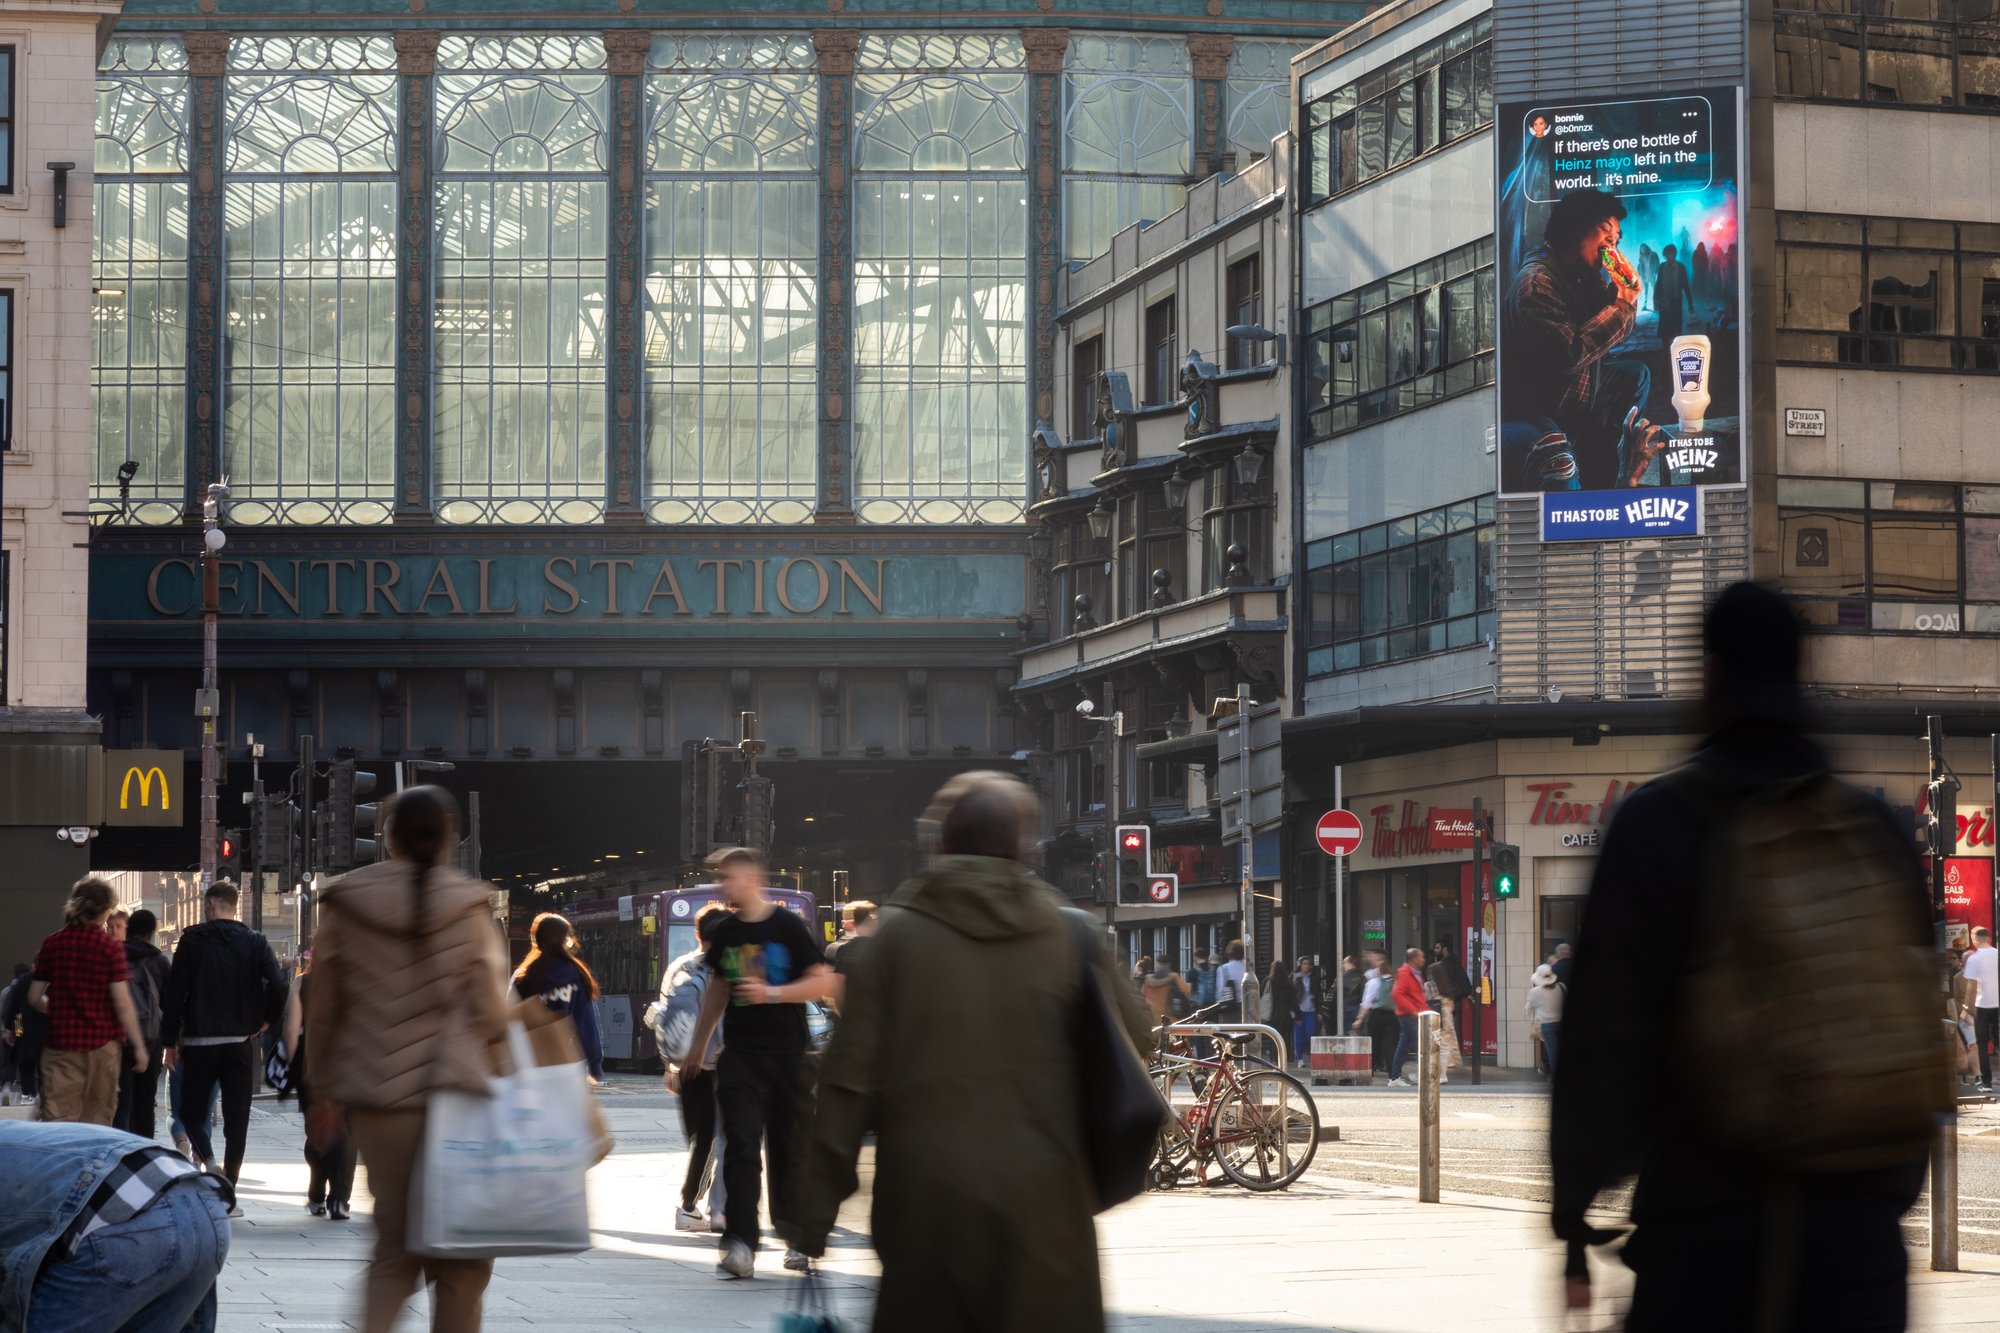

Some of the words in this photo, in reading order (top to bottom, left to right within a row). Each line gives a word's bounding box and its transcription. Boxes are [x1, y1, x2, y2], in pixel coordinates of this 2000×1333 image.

[1555, 113, 1584, 123] bonnie
[1555, 124, 1593, 135] @b0nnzx
[1555, 141, 1563, 153] If
[1567, 138, 1609, 153] there's
[1613, 138, 1638, 149] one
[1641, 133, 1680, 147] bottle
[1683, 131, 1697, 144] of
[1555, 158, 1592, 171] Heinz
[1595, 157, 1631, 170] mayo
[1634, 152, 1656, 166] left
[1659, 152, 1671, 164] in
[1675, 150, 1697, 163] the
[1555, 175, 1602, 189] world...
[1606, 173, 1623, 186] it's
[1626, 171, 1661, 184] mine.
[1792, 411, 1820, 420] UNION
[1788, 420, 1823, 430] STREET
[1669, 439, 1677, 447] IT
[1677, 438, 1692, 447] HAS
[1693, 438, 1704, 446] TO
[1704, 437, 1714, 446] BE
[1665, 448, 1718, 470] HEINZ
[1551, 511, 1562, 523] IT
[1563, 510, 1588, 523] HAS
[1588, 509, 1605, 522] TO
[1605, 508, 1619, 521] BE
[1625, 497, 1689, 523] HEINZ
[146, 556, 518, 616] CENTRAL
[543, 555, 887, 615] STATION
[1527, 782, 1593, 825] Tim
[1434, 819, 1451, 831] Tim
[1562, 829, 1599, 847] CAFÉ
[1949, 896, 1970, 906] today
